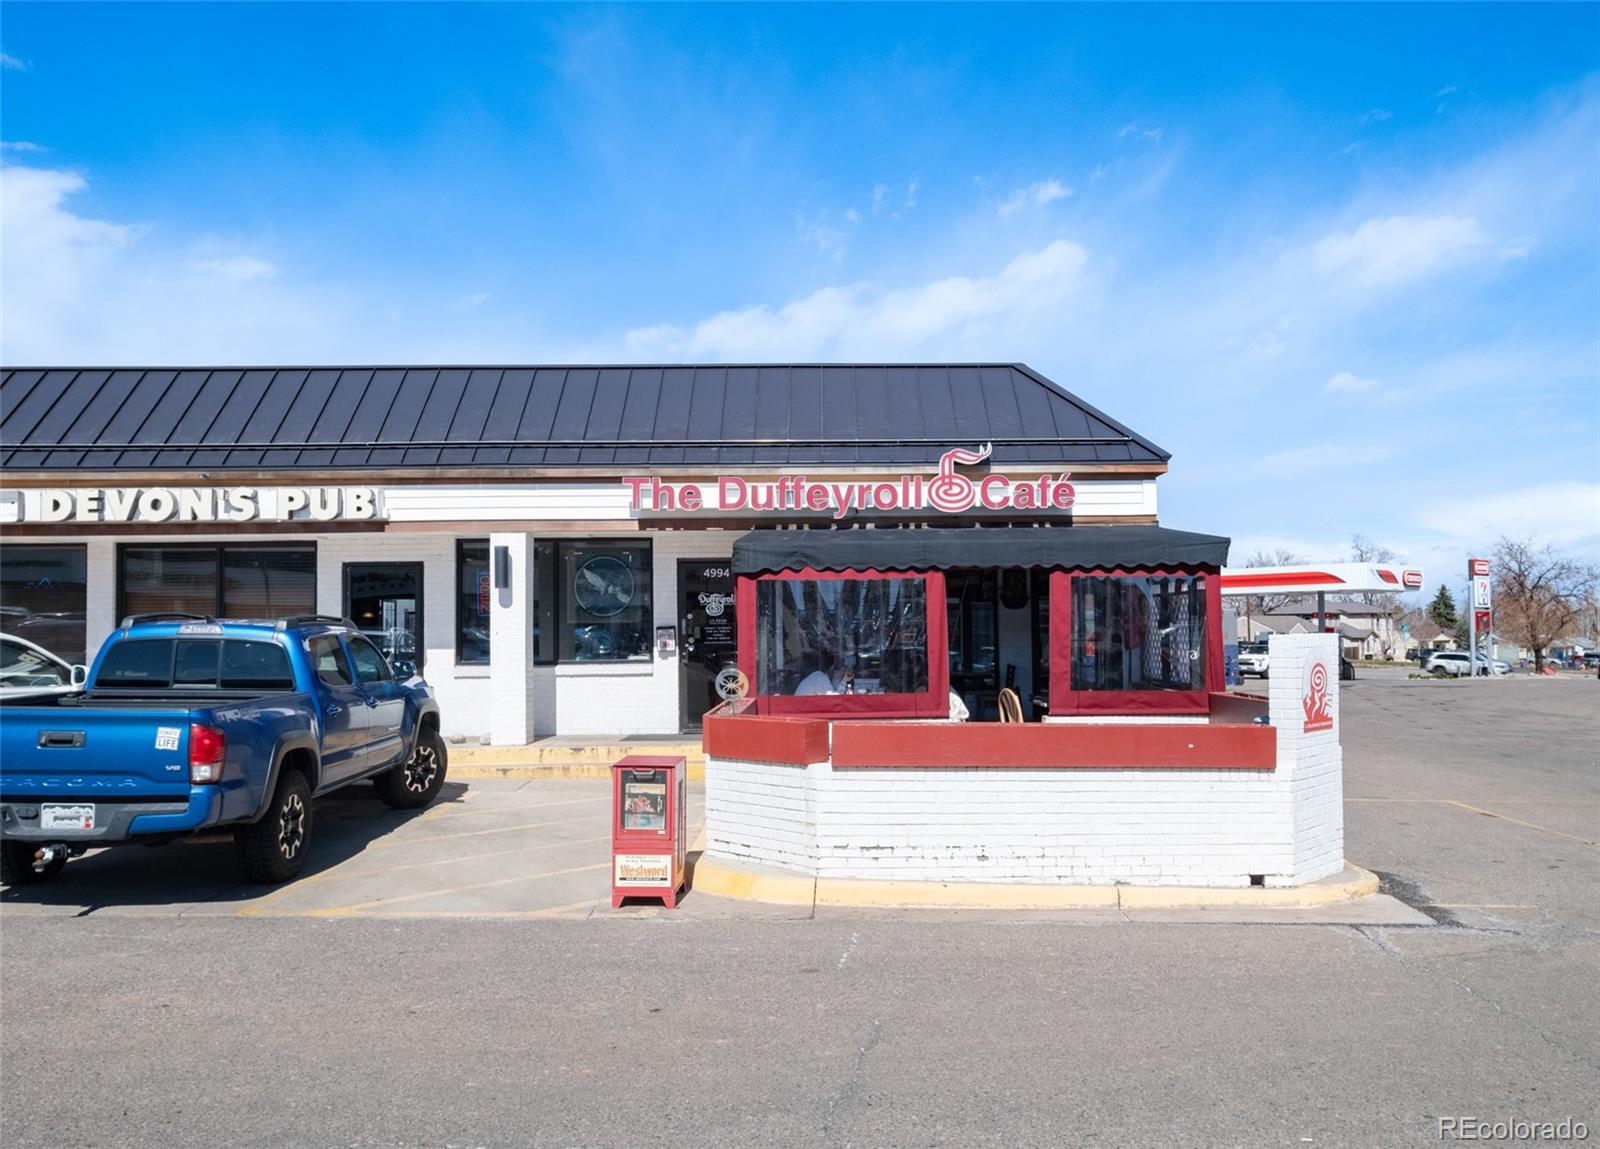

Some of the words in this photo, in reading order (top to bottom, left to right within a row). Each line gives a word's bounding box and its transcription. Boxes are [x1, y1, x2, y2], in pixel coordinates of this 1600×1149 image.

[41, 487, 259, 521] DEVON'S
[277, 487, 377, 521] PUB
[622, 477, 702, 511] The
[718, 476, 922, 518] Duffeyroll
[979, 472, 1076, 510] Café
[703, 568, 730, 578] 4994
[157, 738, 177, 748] LIFE
